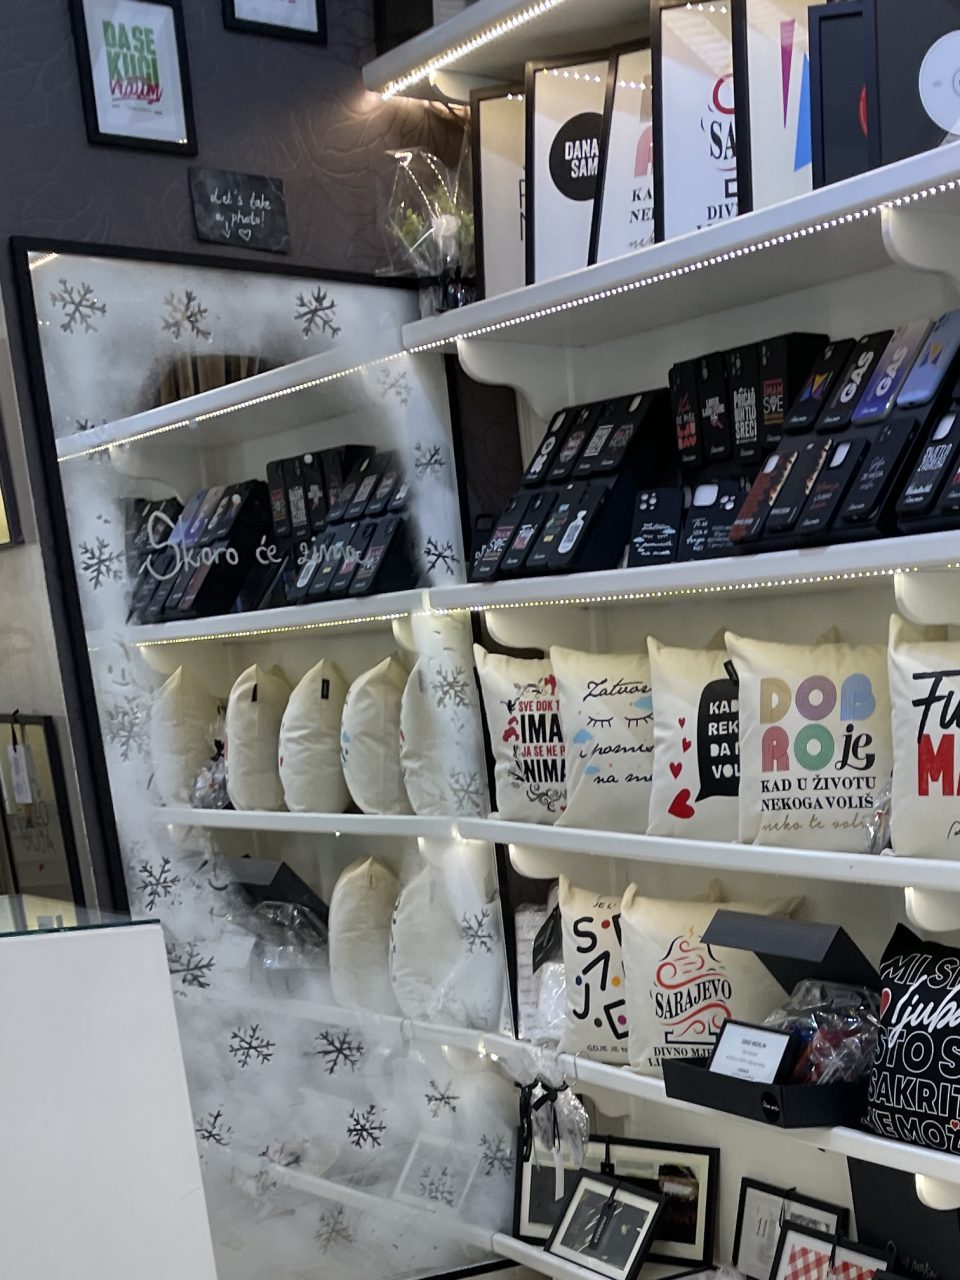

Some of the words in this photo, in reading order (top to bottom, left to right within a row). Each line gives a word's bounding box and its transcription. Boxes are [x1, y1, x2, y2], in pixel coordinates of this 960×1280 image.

[565, 138, 600, 161] DANA
[571, 158, 599, 178] SAM
[250, 192, 272, 210] take
[232, 212, 265, 228] photo!
[840, 351, 875, 404] GAS
[875, 347, 908, 397] GAS
[138, 510, 239, 580] Skoro
[256, 535, 283, 564] će
[518, 700, 534, 712] SVE
[536, 700, 553, 712] DOK
[520, 713, 564, 744] IMA
[522, 746, 532, 758] JA
[534, 745, 544, 757] SE
[546, 745, 558, 757] NE
[710, 742, 731, 757] DA
[835, 723, 876, 771] je
[593, 774, 619, 784] na
[760, 777, 792, 793] KAD
[797, 778, 808, 791] U
[812, 774, 877, 791] ŽIVOTU
[760, 795, 823, 812] NEKOGA
[826, 793, 875, 810] VOLIŠ
[761, 815, 802, 833] neko
[880, 953, 932, 986] MI
[655, 979, 732, 1020] SARAJEVO
[653, 1046, 688, 1057] DIVNO
